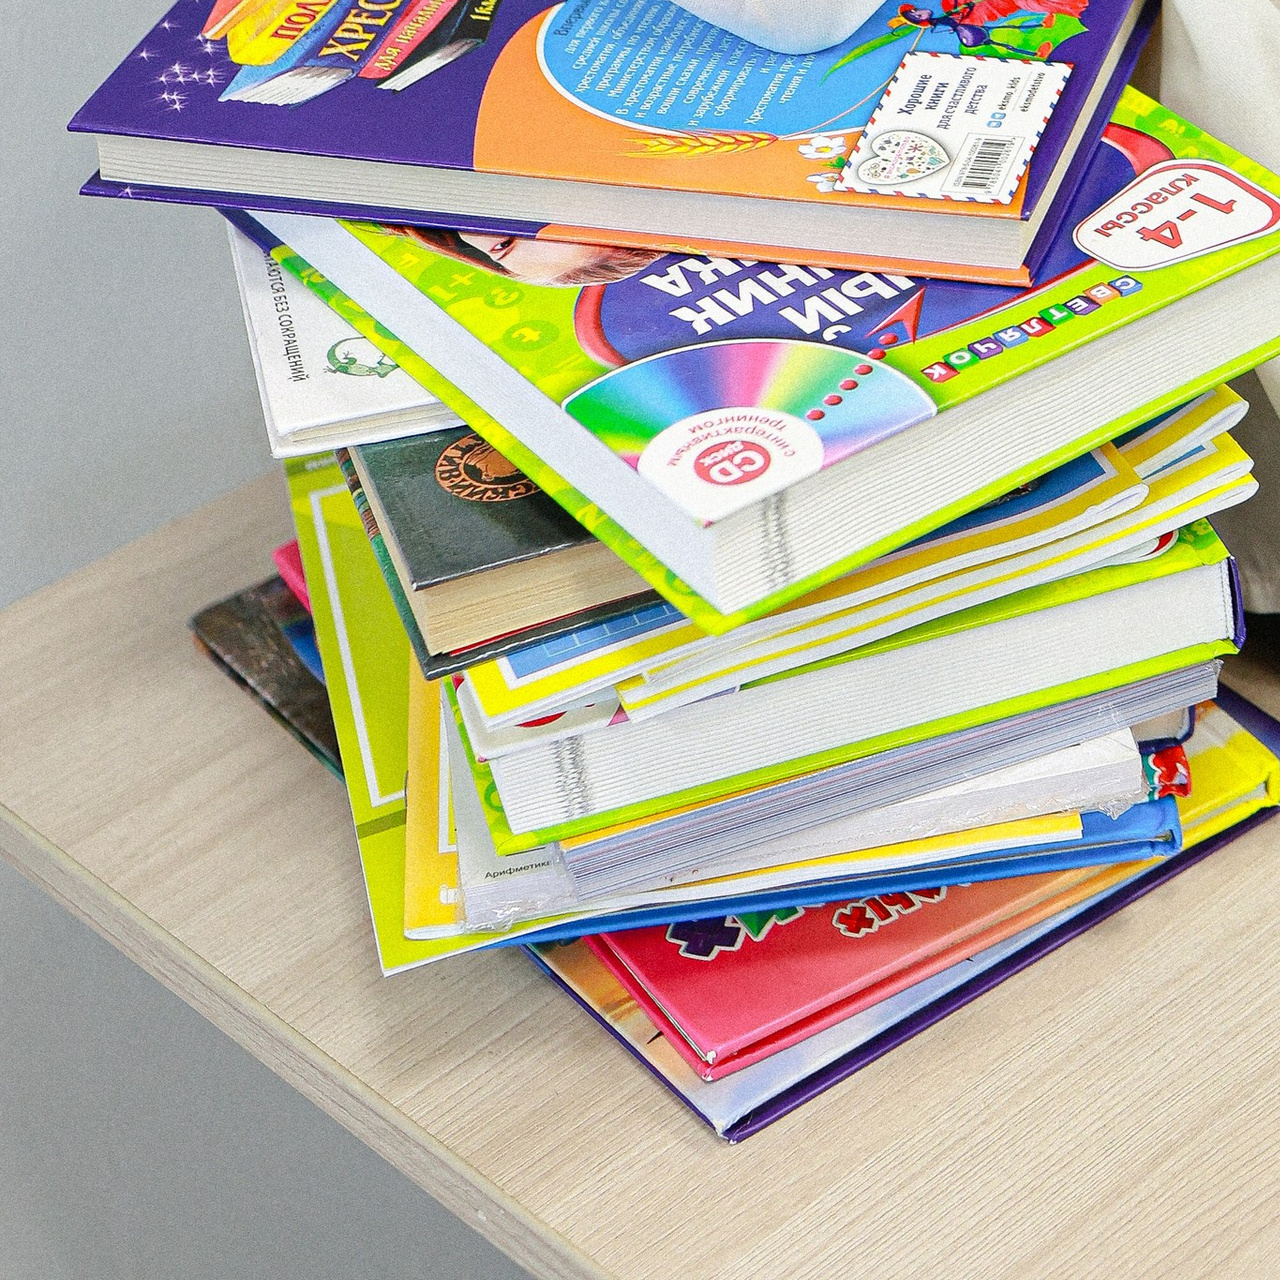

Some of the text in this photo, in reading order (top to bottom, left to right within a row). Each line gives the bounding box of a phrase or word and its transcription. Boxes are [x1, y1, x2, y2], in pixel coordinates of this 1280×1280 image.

[373, 46, 402, 71] для
[572, 37, 600, 69] средней
[595, 47, 632, 91] программы
[607, 38, 656, 97] Министерством
[624, 56, 664, 106] хрестоматии
[658, 19, 687, 54] наиболее
[640, 64, 678, 110] возрастные
[657, 88, 681, 114] вошли
[676, 59, 699, 85] сказки,
[683, 53, 722, 103] современной
[694, 70, 730, 118] зарубежной
[714, 59, 756, 116] сформировать
[744, 73, 785, 124] Хрестоматия
[779, 76, 803, 103] чтения
[897, 75, 932, 115] Хорошие
[925, 83, 949, 110] книги
[937, 68, 976, 128] для счастливого
[965, 85, 987, 114] детства
[998, 77, 1020, 110] eksmo_kids
[1020, 73, 1045, 112] eksmodetstvo
[1094, 173, 1200, 238] классы
[1136, 192, 1237, 250] 1-4
[274, 294, 289, 313] БЕЗ
[926, 279, 1141, 381] СВЕТЛЯЧОК
[687, 415, 787, 434] тренингом
[709, 450, 765, 484] CD
